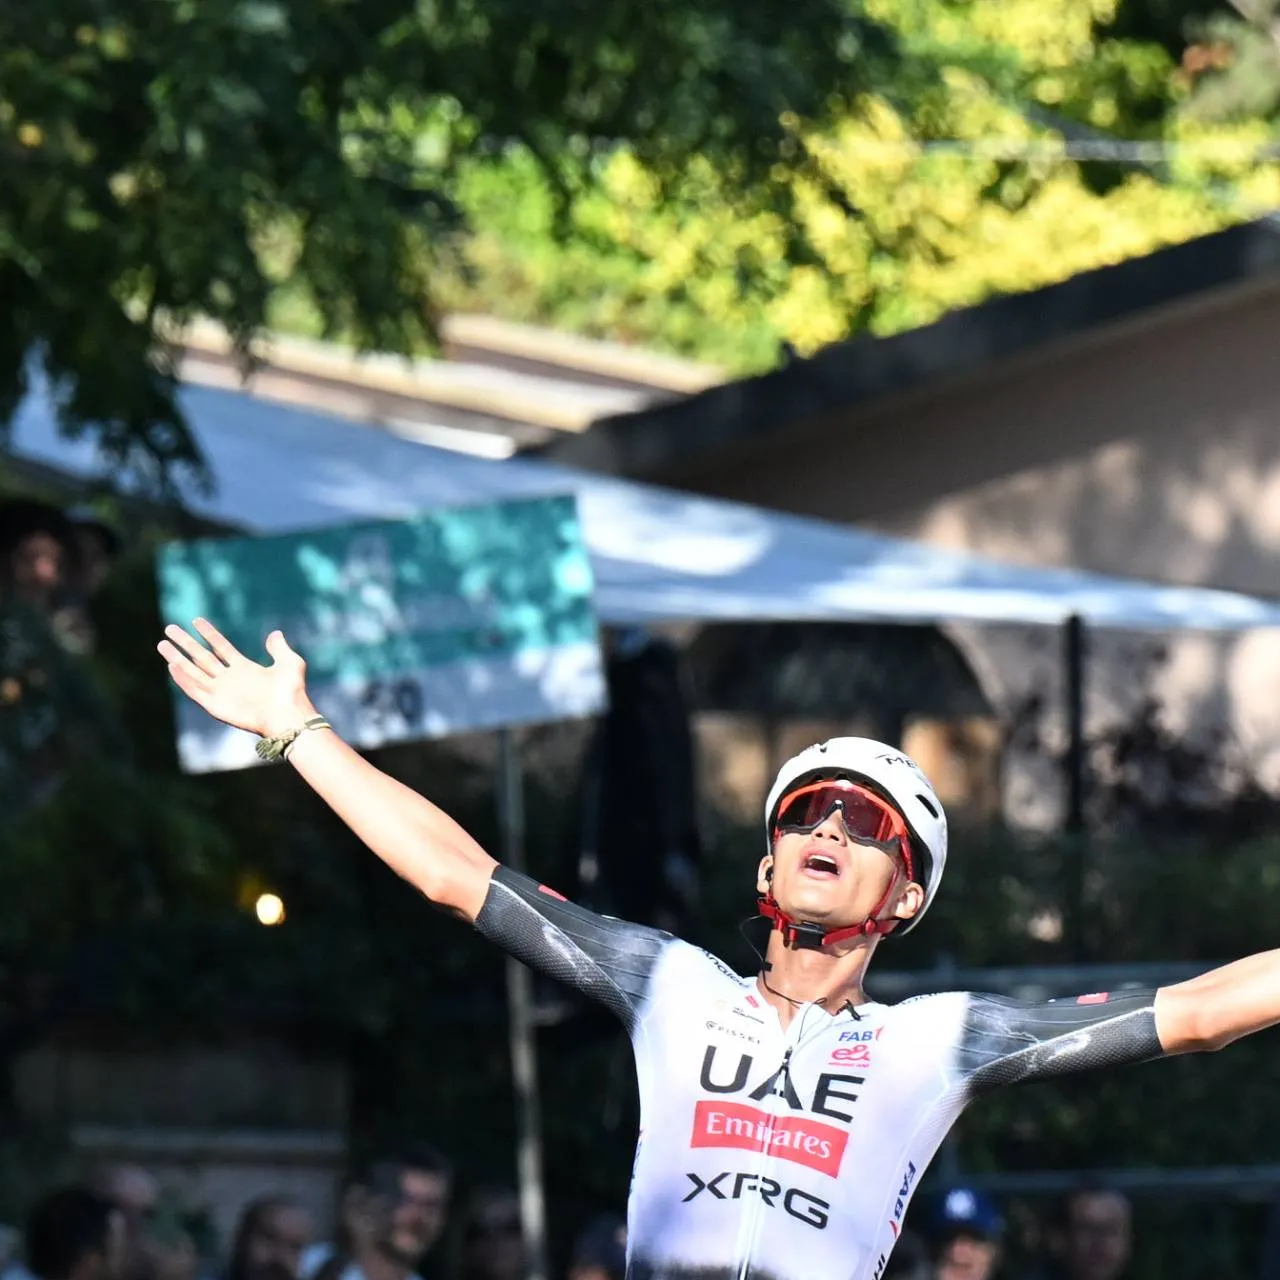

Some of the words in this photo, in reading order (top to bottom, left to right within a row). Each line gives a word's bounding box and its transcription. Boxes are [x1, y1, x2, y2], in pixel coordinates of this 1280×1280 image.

[838, 1030, 872, 1042] FAB
[699, 1045, 866, 1123] UAE
[706, 1111, 832, 1160] Emirates
[682, 1172, 831, 1230] XRG
